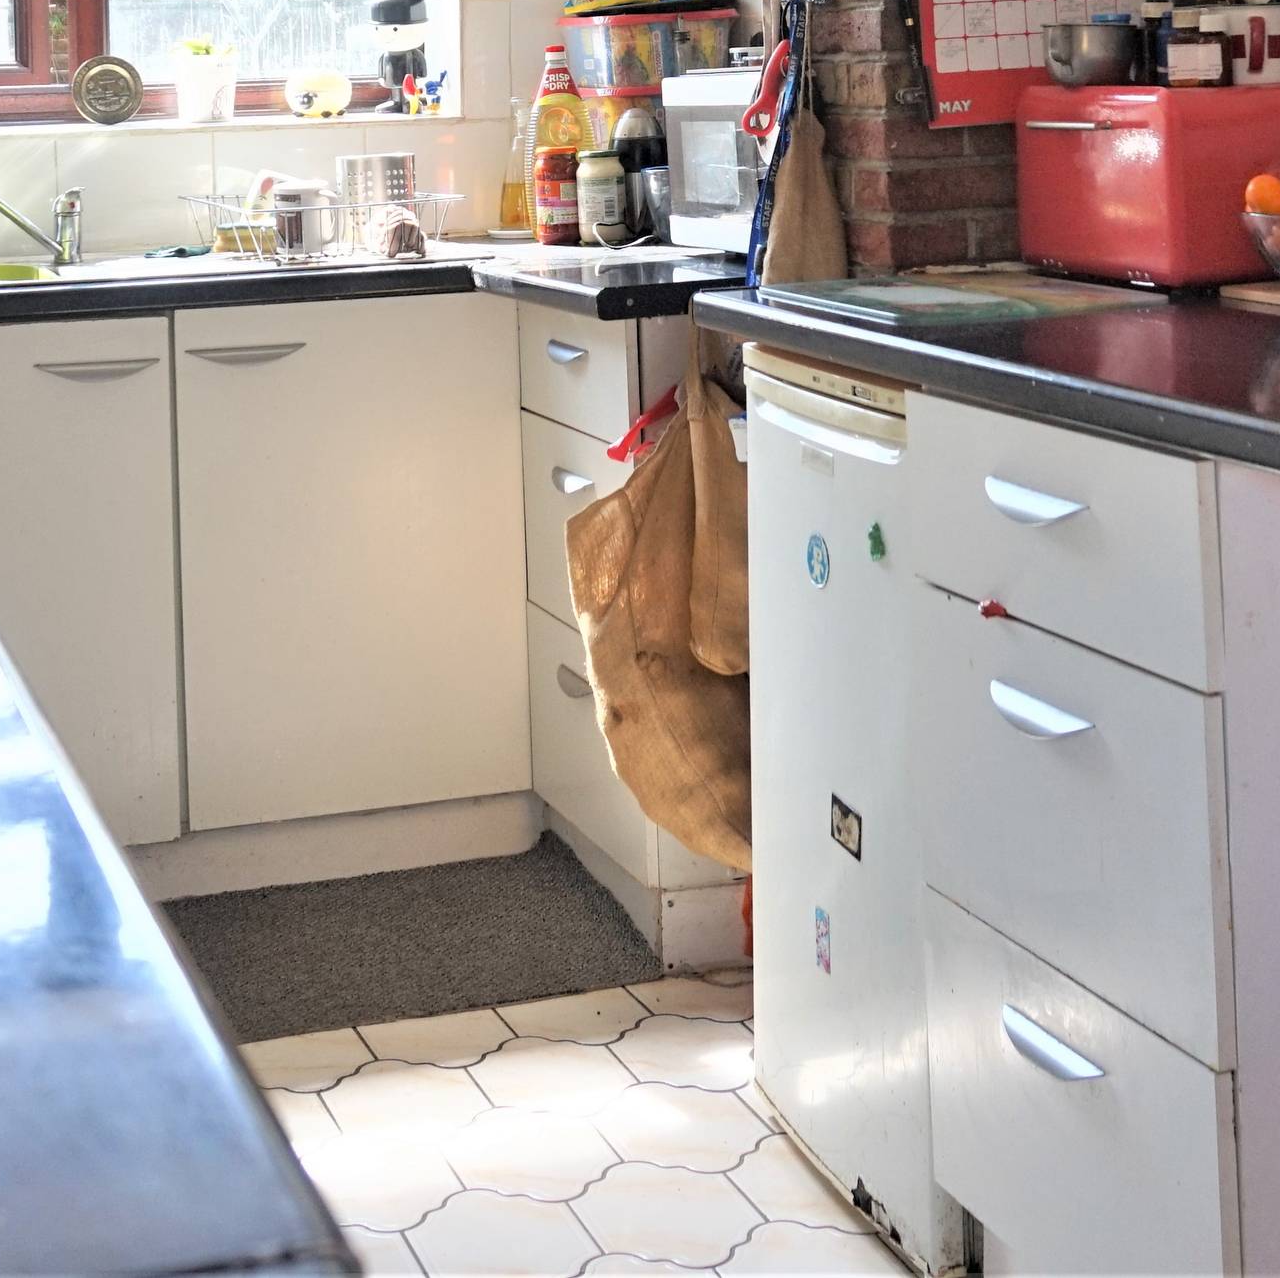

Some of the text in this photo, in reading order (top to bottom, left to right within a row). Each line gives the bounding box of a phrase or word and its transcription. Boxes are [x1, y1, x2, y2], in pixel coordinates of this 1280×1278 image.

[795, 8, 807, 40] STAFF
[544, 73, 570, 84] CRISP
[786, 53, 799, 82] STAFF
[550, 82, 570, 92] DRY
[938, 99, 972, 114] MAY
[762, 198, 774, 228] STAFF
